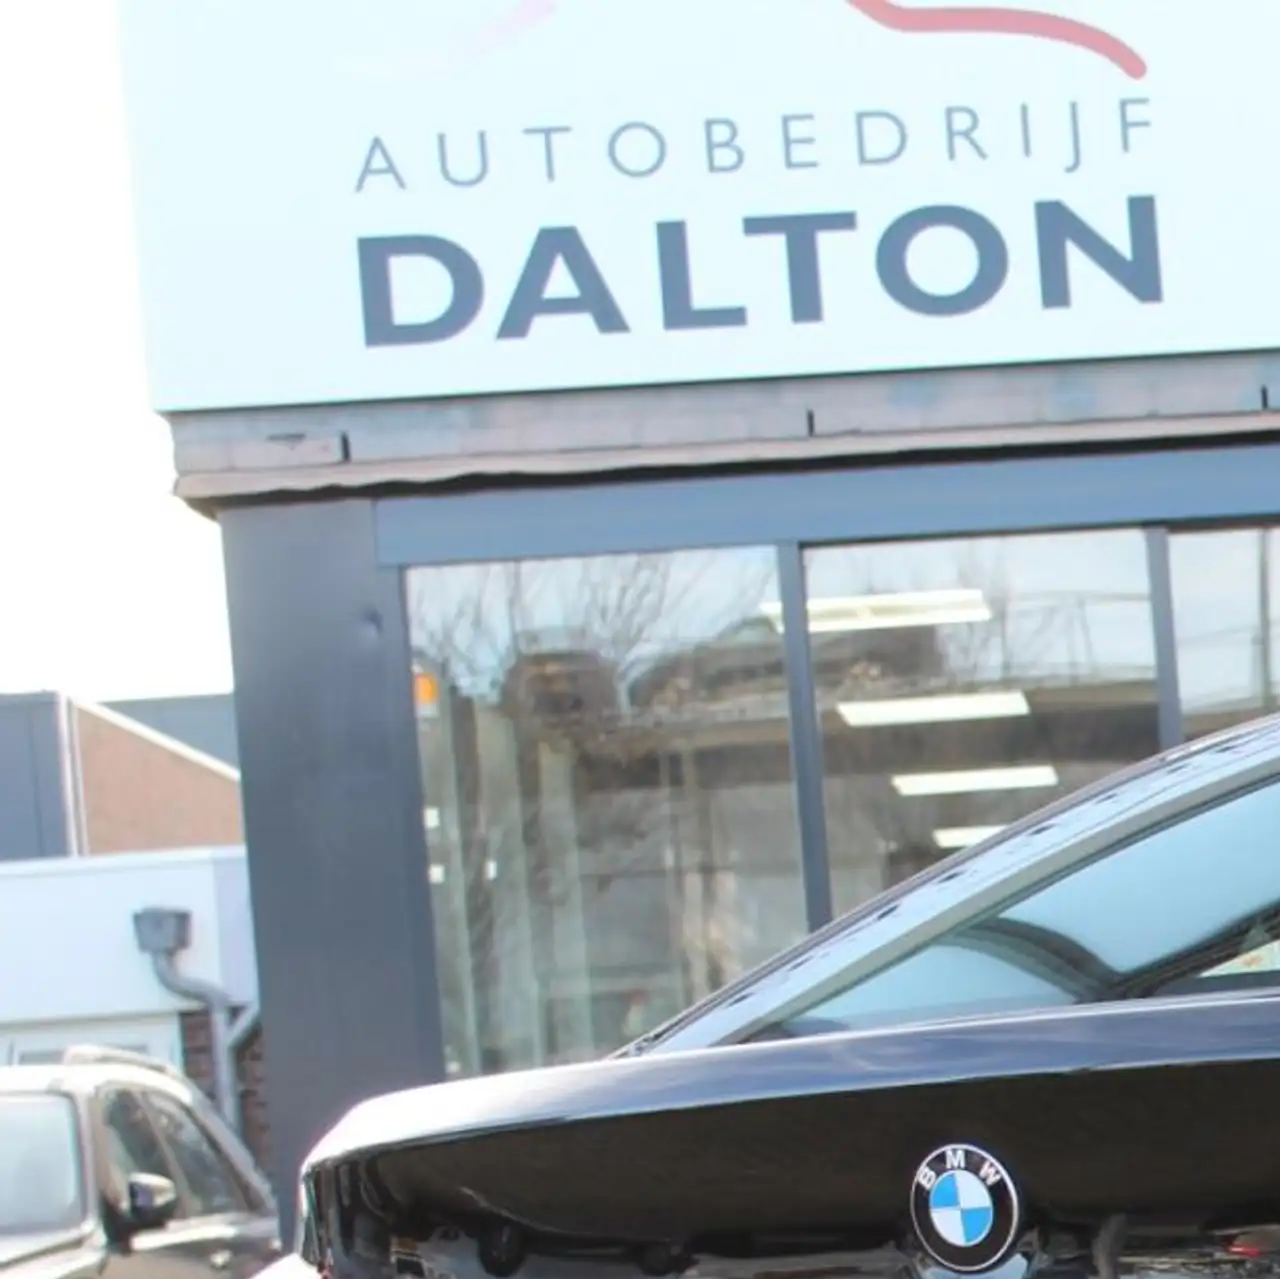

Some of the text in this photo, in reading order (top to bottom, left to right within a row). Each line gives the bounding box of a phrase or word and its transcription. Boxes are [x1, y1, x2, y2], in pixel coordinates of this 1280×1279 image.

[353, 96, 1153, 194] AUTOBEDRIJF
[356, 193, 1164, 349] DALTON
[917, 1148, 1002, 1191] BMW
